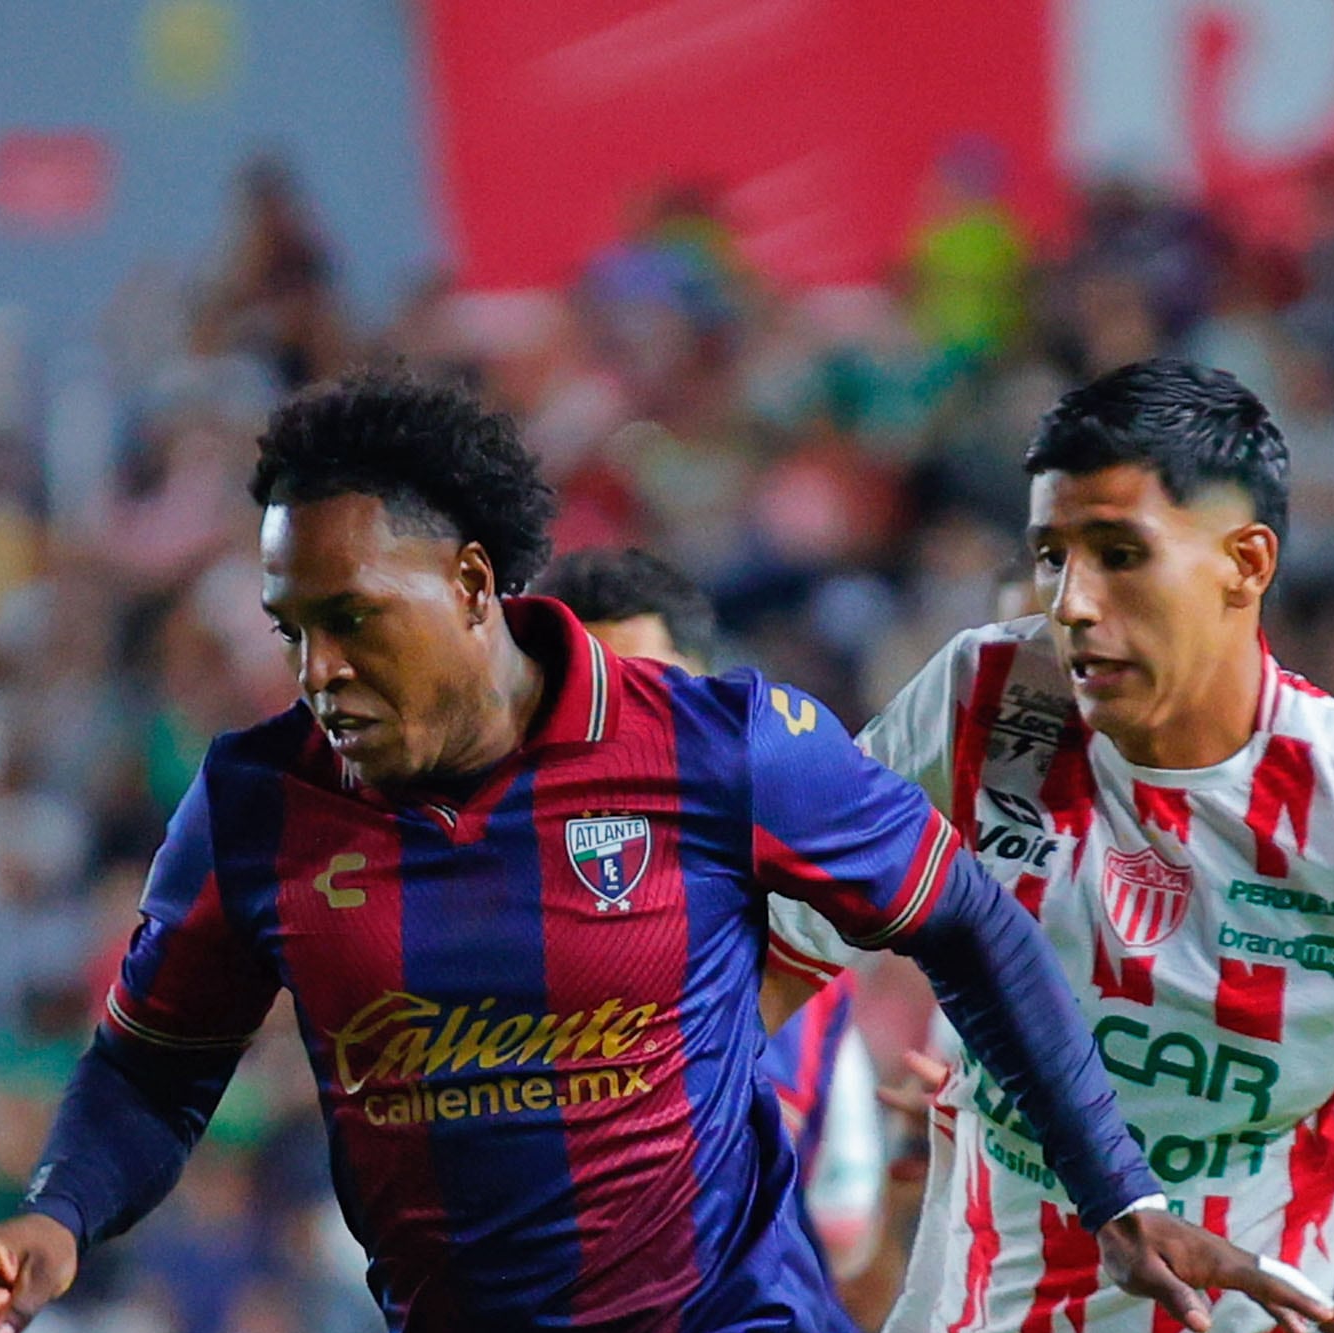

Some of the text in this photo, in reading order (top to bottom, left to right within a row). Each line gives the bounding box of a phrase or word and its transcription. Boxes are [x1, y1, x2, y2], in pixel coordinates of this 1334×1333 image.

[575, 822, 642, 850] ATLANTE
[977, 821, 1058, 868] Voit
[324, 990, 658, 1094] Caliente
[366, 1065, 653, 1126] caliente.mx
